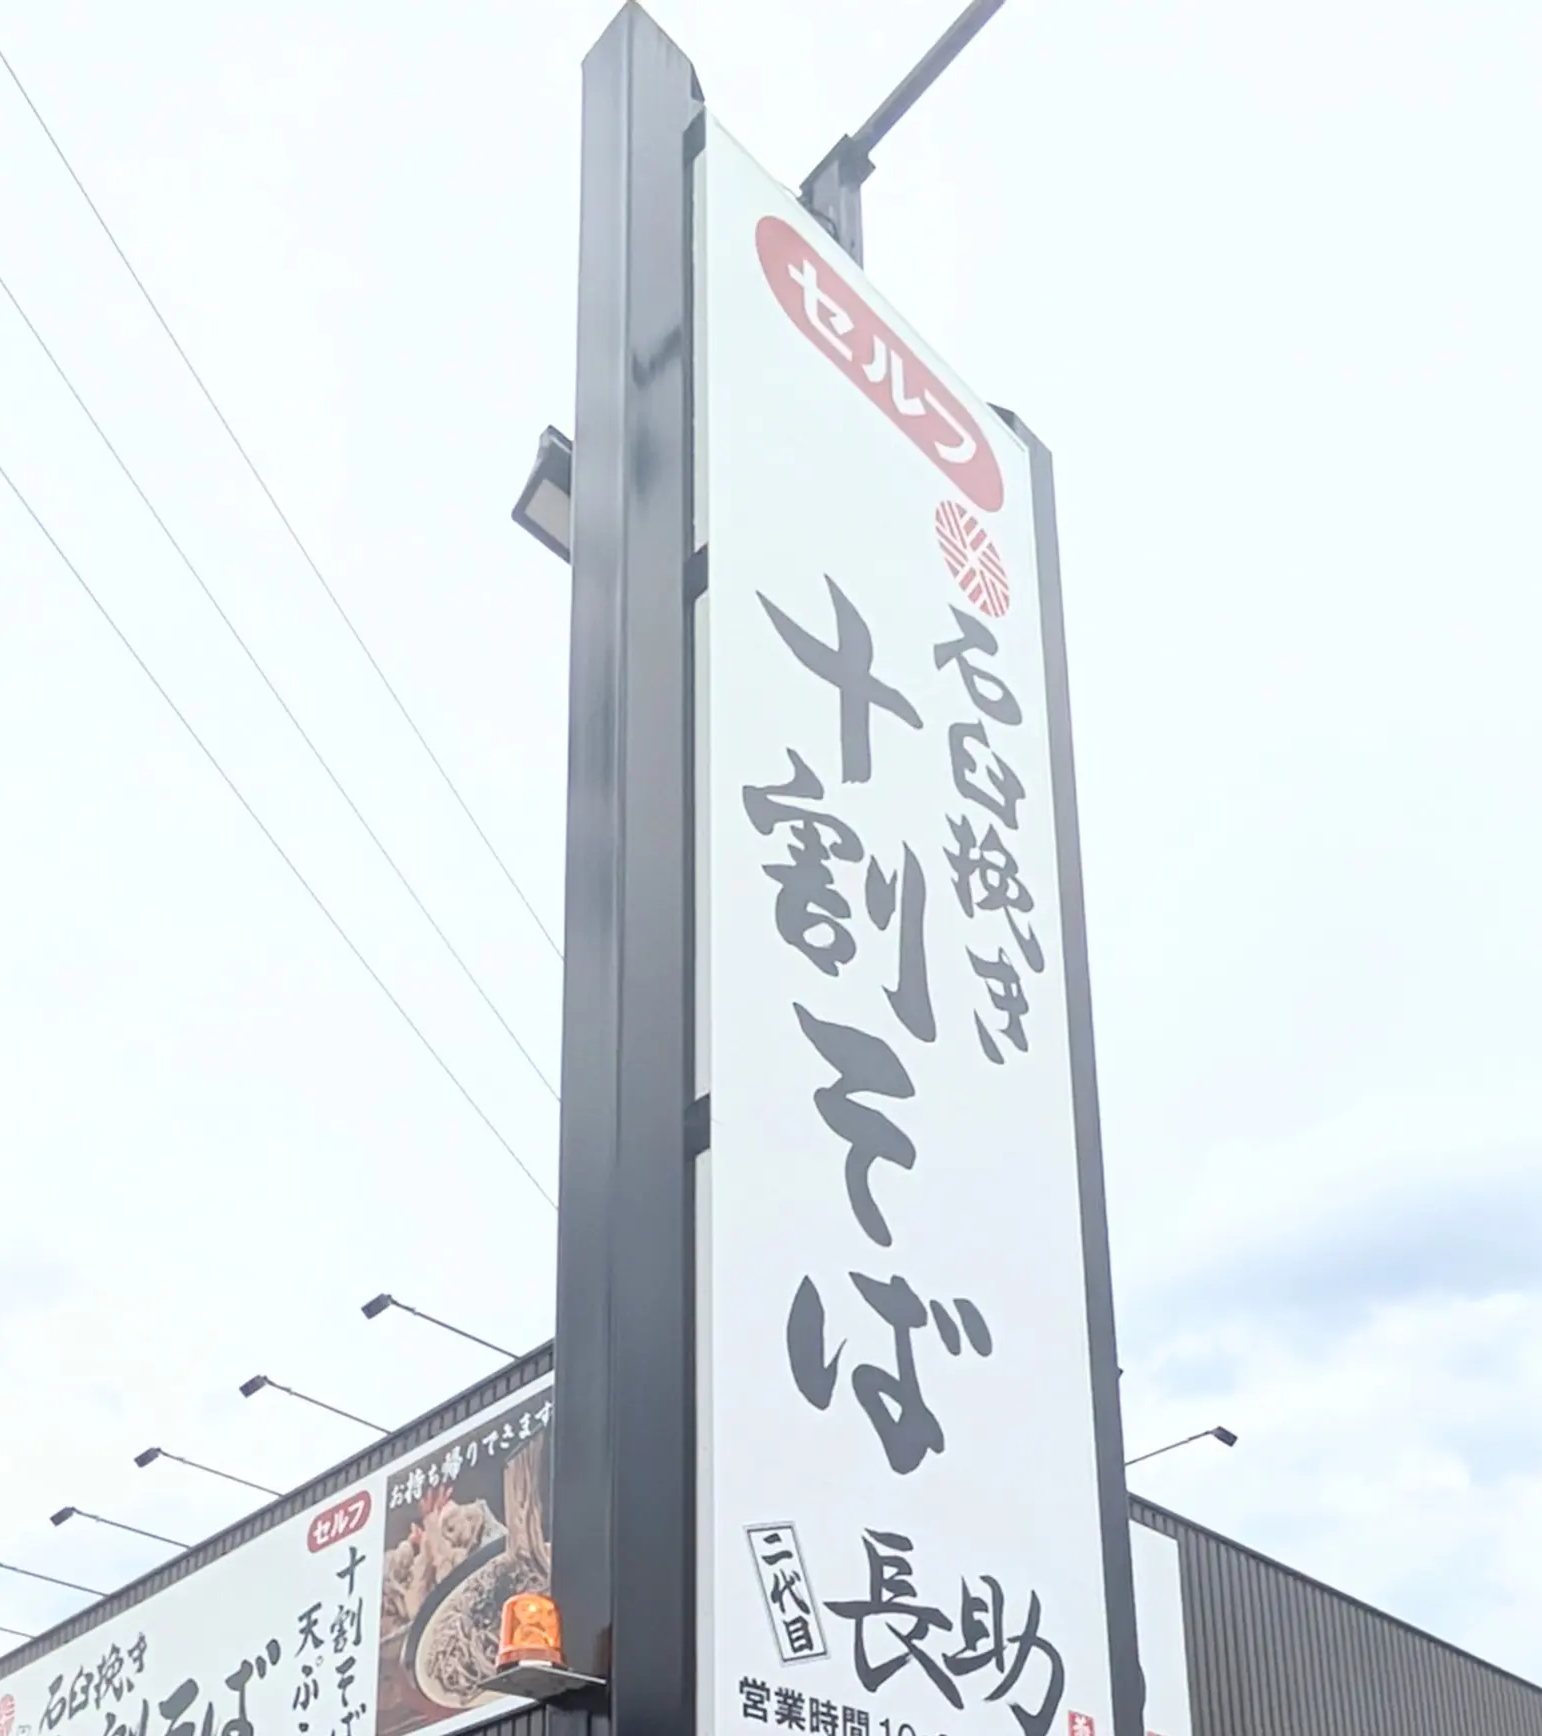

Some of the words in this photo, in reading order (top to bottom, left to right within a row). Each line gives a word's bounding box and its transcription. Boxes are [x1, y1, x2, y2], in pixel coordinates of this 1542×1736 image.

[787, 257, 979, 465] セルフ
[742, 572, 994, 1476] 十割そば
[388, 1399, 553, 1510] お持ち帰りできます
[312, 1499, 368, 1546] セルフ
[760, 1531, 817, 1657] 二代目
